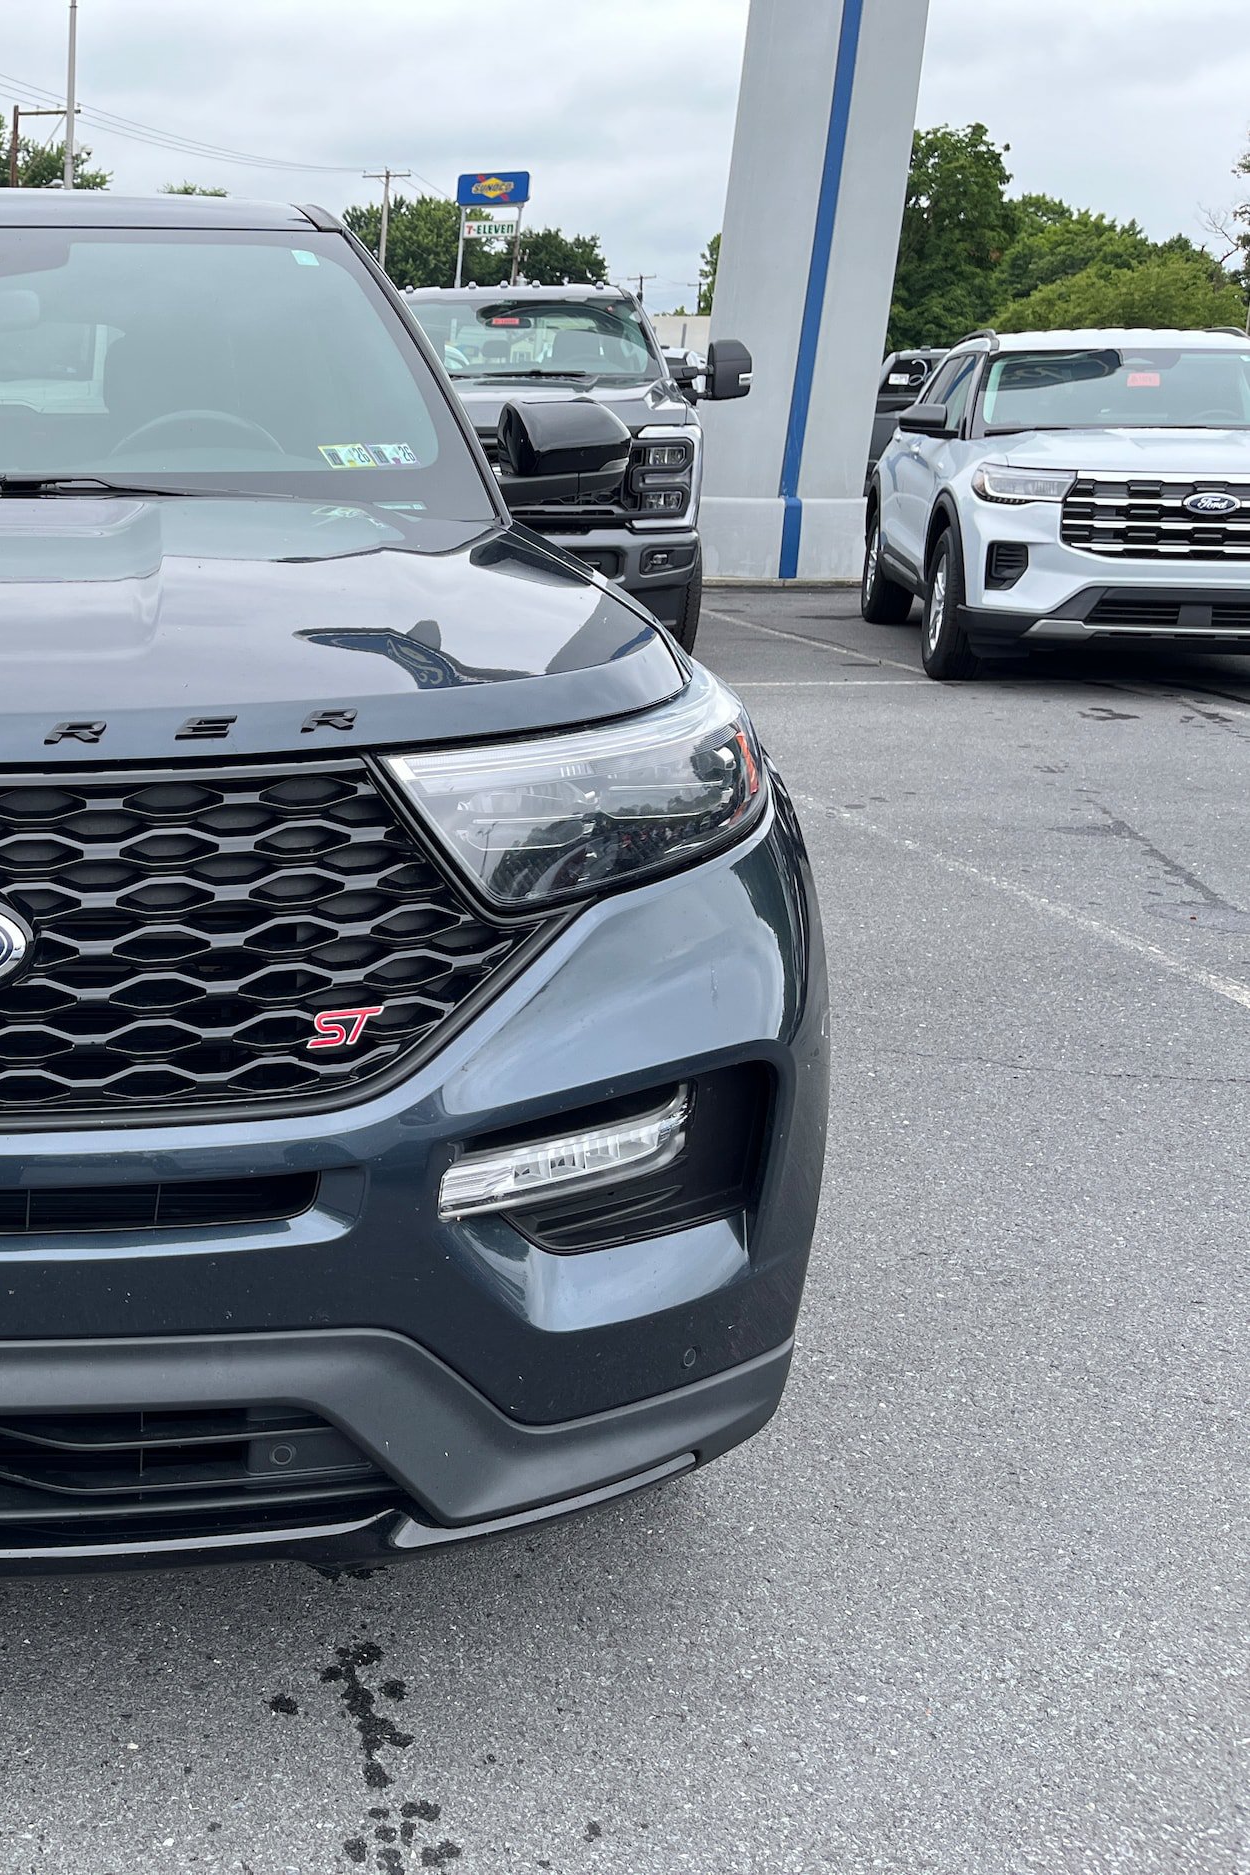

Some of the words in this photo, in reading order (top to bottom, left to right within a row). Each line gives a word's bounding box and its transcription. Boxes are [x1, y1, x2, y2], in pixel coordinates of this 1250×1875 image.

[472, 182, 514, 194] SUNOCO
[352, 447, 371, 462] 26
[398, 446, 416, 462] 26
[1197, 497, 1228, 510] Ford
[306, 1005, 385, 1050] ST
